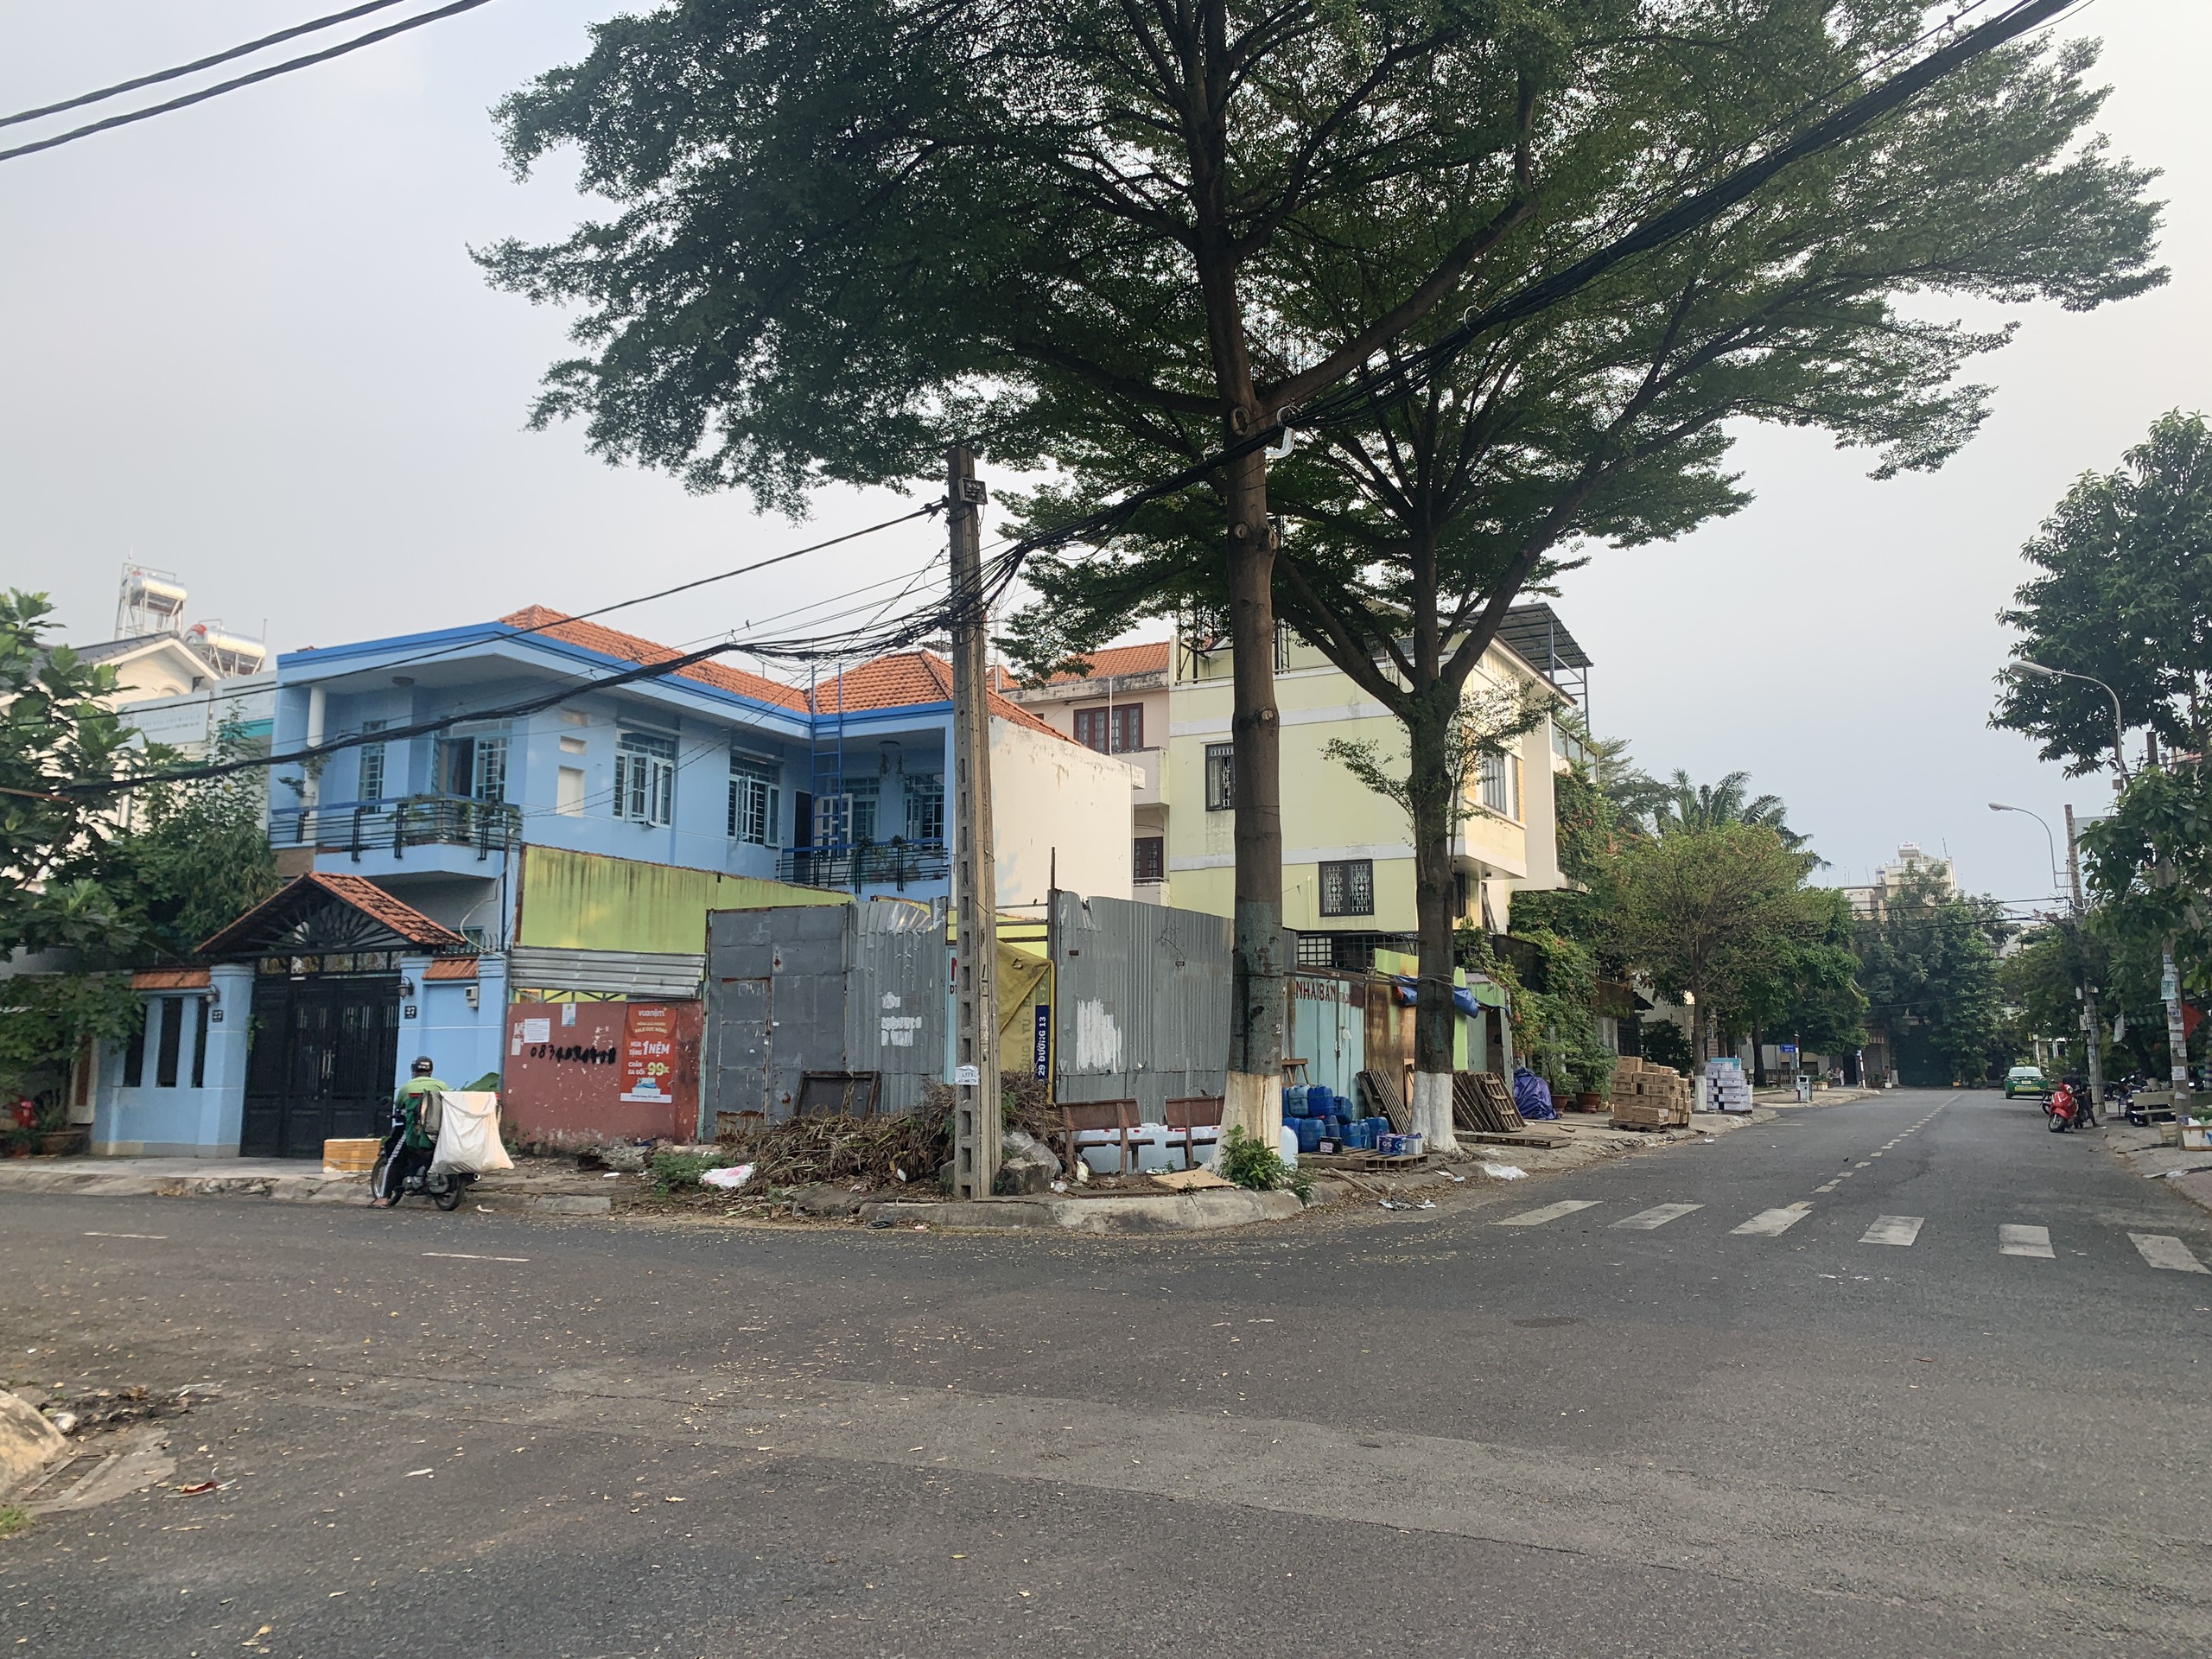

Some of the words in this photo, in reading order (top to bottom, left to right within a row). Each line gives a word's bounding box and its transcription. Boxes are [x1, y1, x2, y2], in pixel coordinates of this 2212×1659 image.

[1319, 980, 1336, 1002] BÁN
[406, 1007, 415, 1015] 27
[1039, 1016, 1046, 1027] 13
[1037, 1030, 1046, 1062] ĐƯỜNG
[1038, 1065, 1046, 1076] 29
